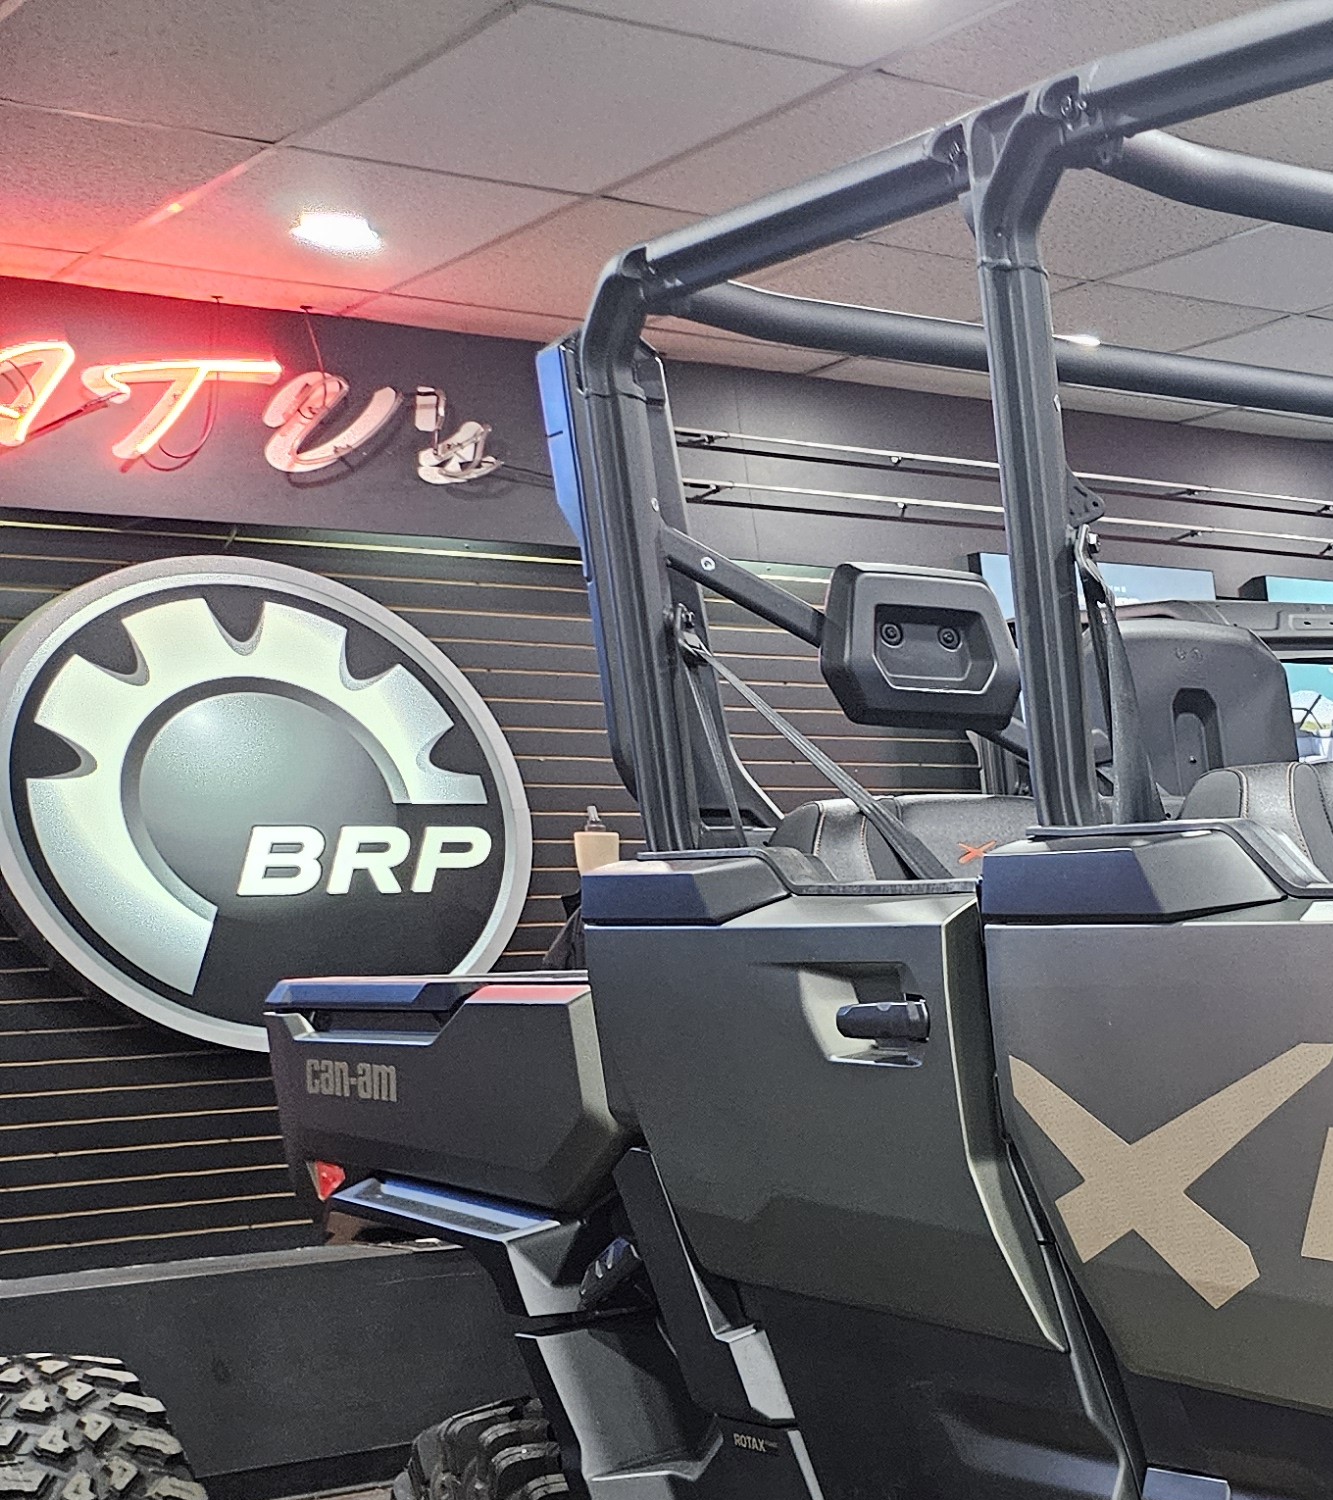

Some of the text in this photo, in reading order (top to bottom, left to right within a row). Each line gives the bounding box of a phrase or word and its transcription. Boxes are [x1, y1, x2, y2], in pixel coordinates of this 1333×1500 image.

[237, 825, 493, 897] BRP
[305, 1058, 397, 1102] can-am
[733, 1432, 766, 1453] ROTAX
